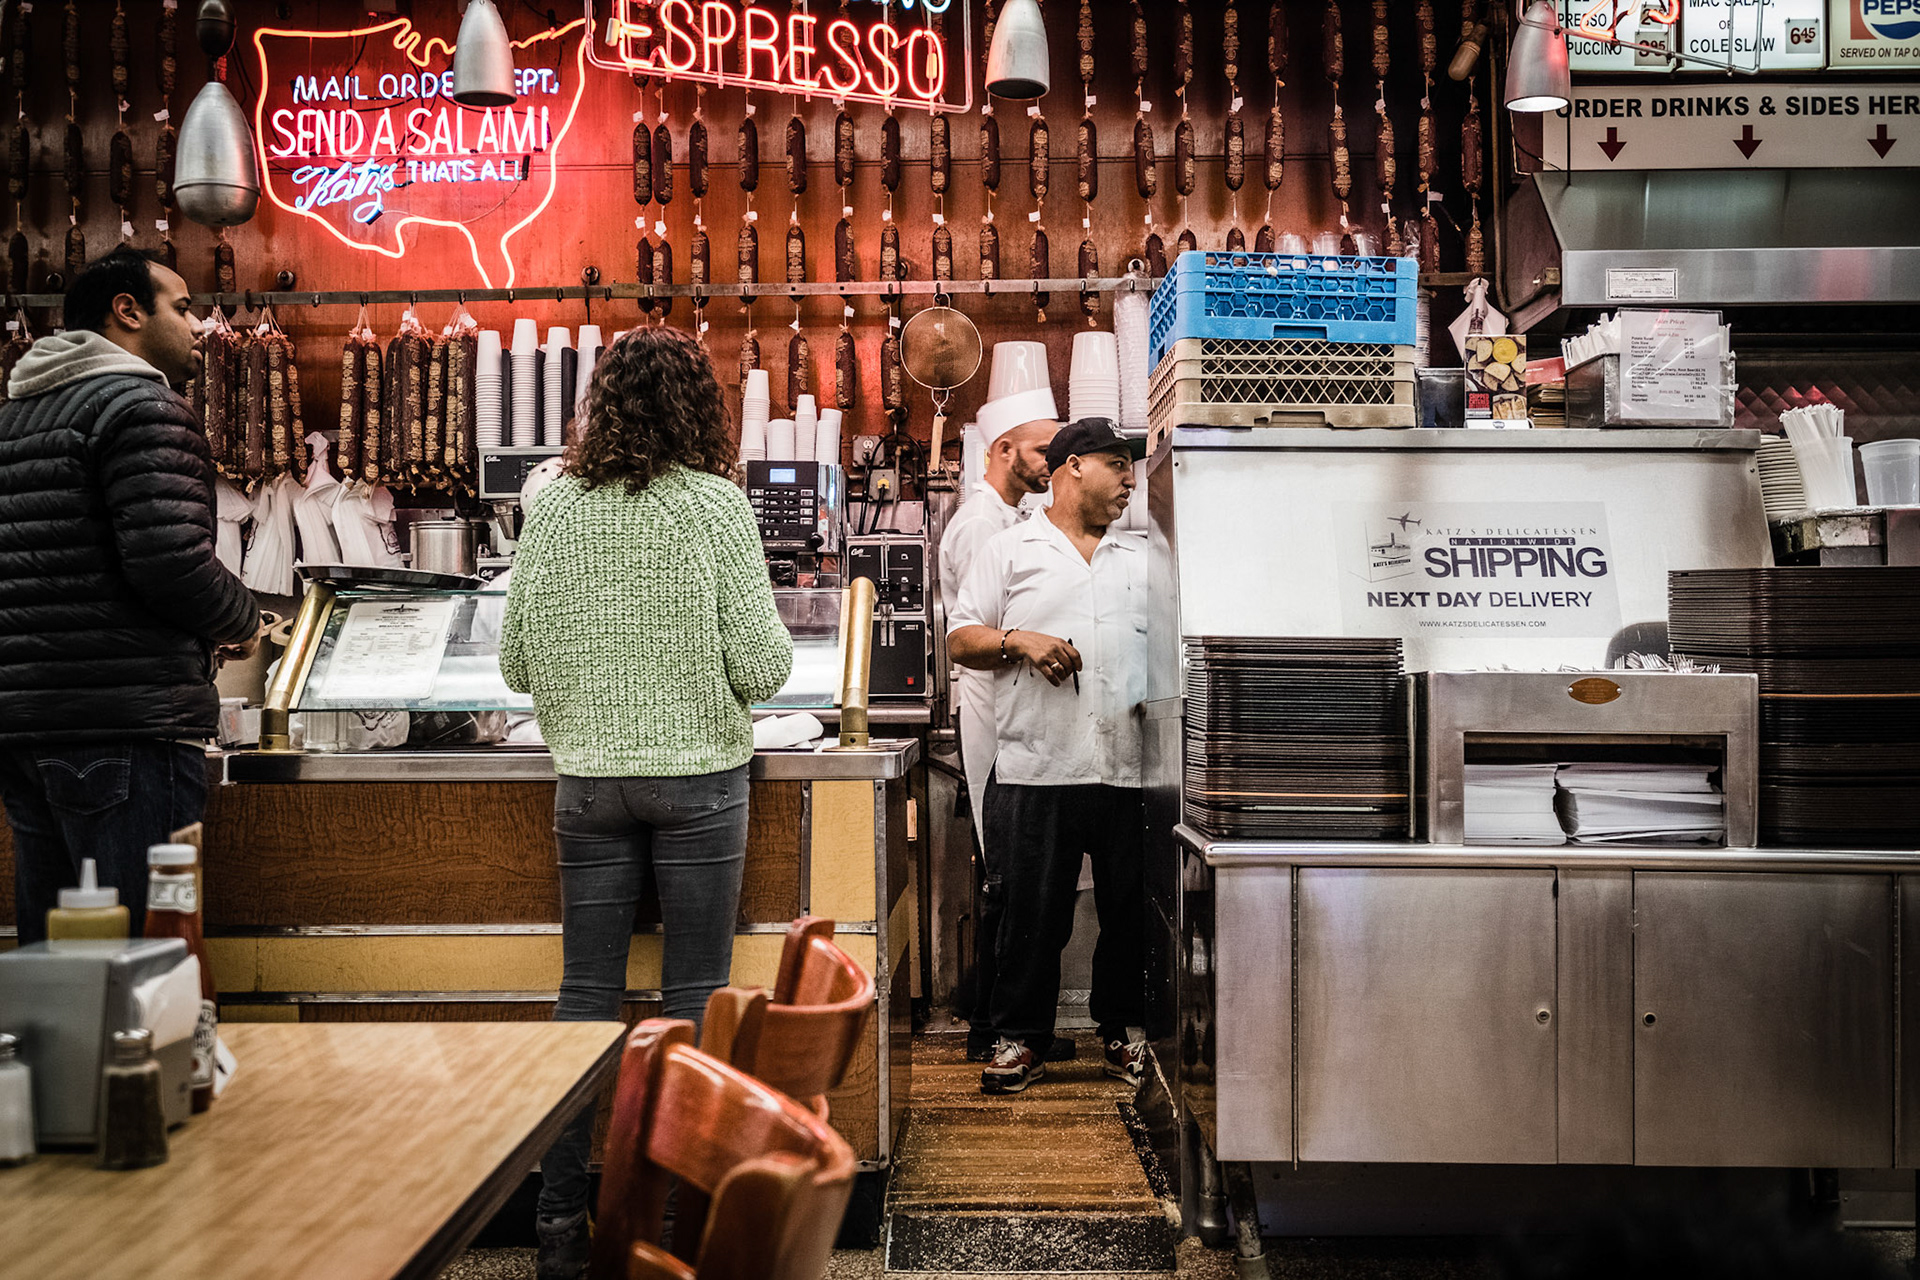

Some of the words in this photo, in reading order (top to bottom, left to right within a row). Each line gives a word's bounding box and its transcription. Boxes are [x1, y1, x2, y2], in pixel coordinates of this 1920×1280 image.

[619, 0, 946, 98] ESPRESSO
[1690, 38, 1729, 53] COLE
[1840, 47, 1876, 58] SERVED
[1878, 47, 1891, 57] ON
[1894, 47, 1911, 57] TAP
[293, 75, 369, 103] MAIL
[378, 71, 454, 99] ORDE
[1556, 98, 1643, 118] ORDER
[1651, 96, 1750, 117] DRINKS
[1758, 96, 1777, 115] &
[1785, 95, 1860, 116] SIDES
[269, 109, 364, 156] SEND
[370, 107, 399, 155] A
[407, 106, 549, 155] SALAMI
[480, 159, 525, 181] ALL
[1426, 528, 1477, 536] KATZ'S
[1486, 527, 1597, 536] DELICATESSEN
[1450, 538, 1575, 546] NATIONWIDE
[1424, 547, 1608, 578] SHIPPING
[1367, 592, 1430, 608] NEXT
[1437, 592, 1482, 607] DAY
